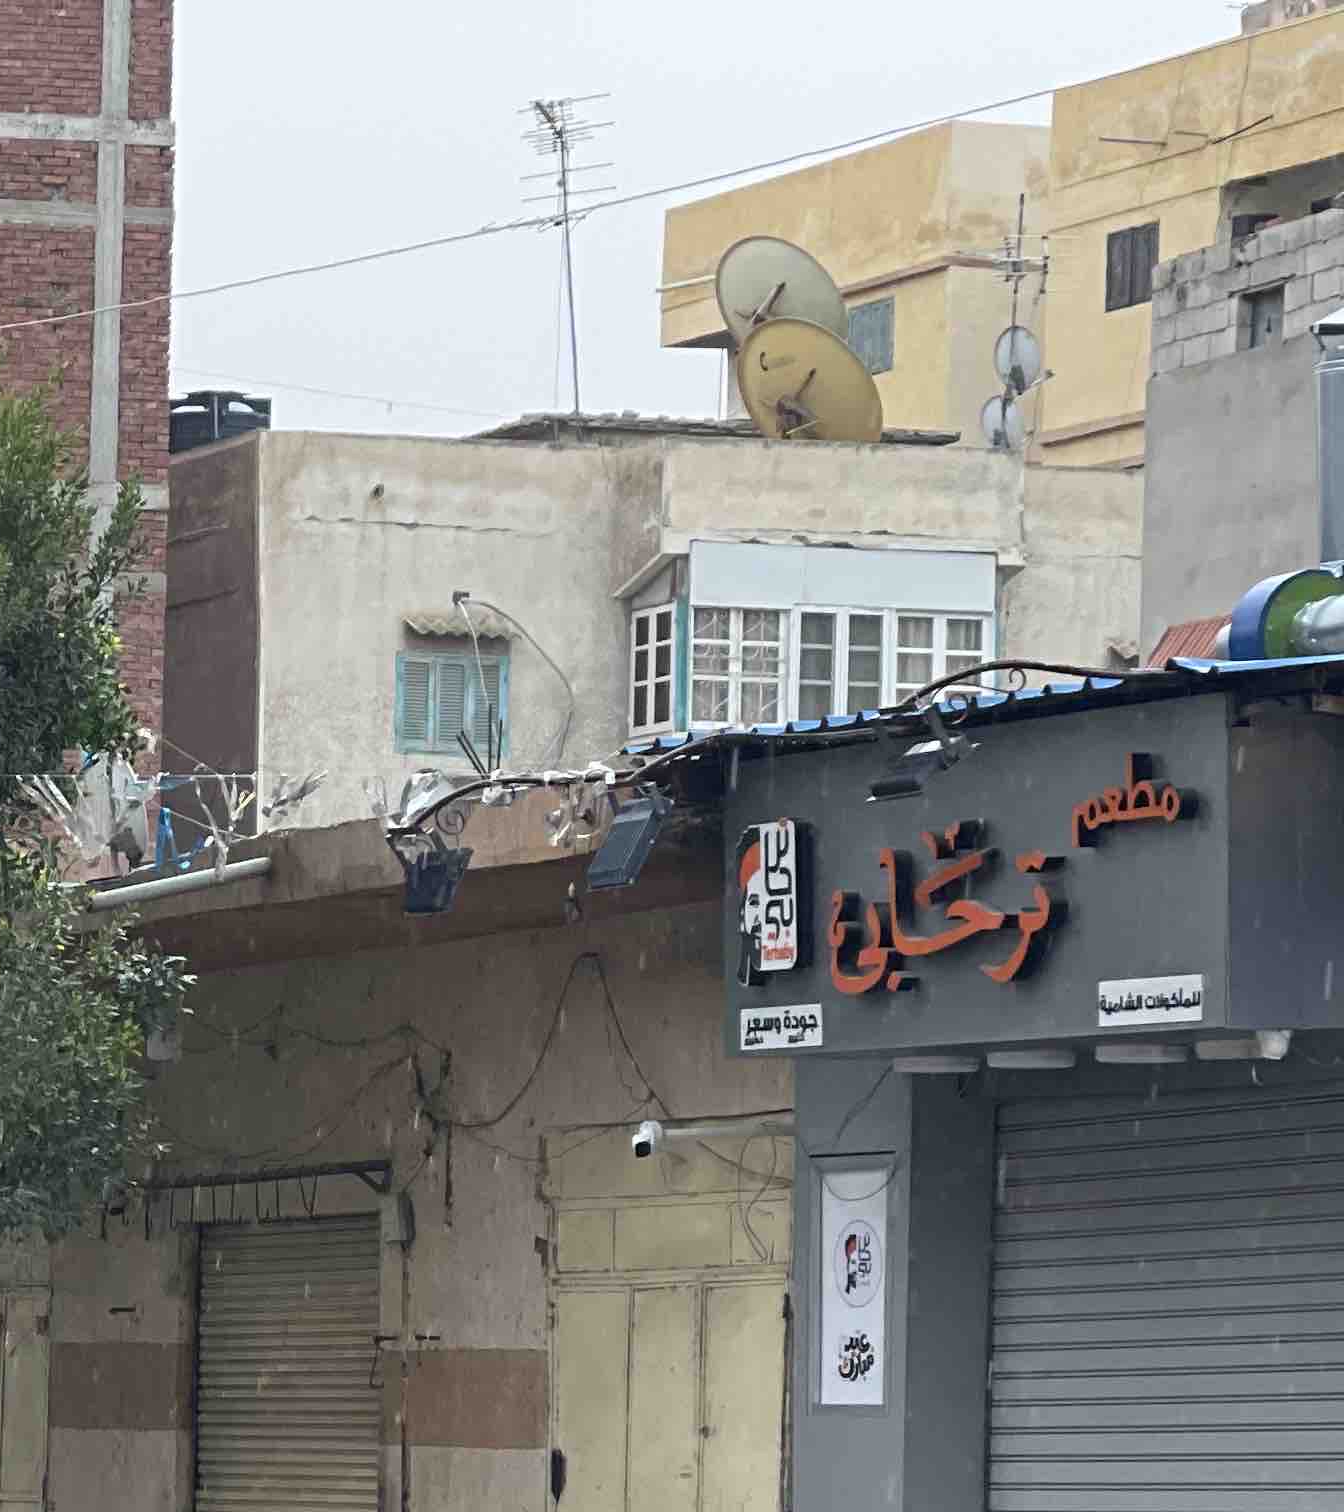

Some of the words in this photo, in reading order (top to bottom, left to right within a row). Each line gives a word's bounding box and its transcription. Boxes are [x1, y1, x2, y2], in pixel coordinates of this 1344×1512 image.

[1071, 753, 1181, 848] مطعم
[1100, 991, 1143, 1015] الشامية
[1145, 987, 1201, 1011] للمأكولات
[746, 1016, 782, 1037] وسعر
[783, 1009, 818, 1037] جودة
